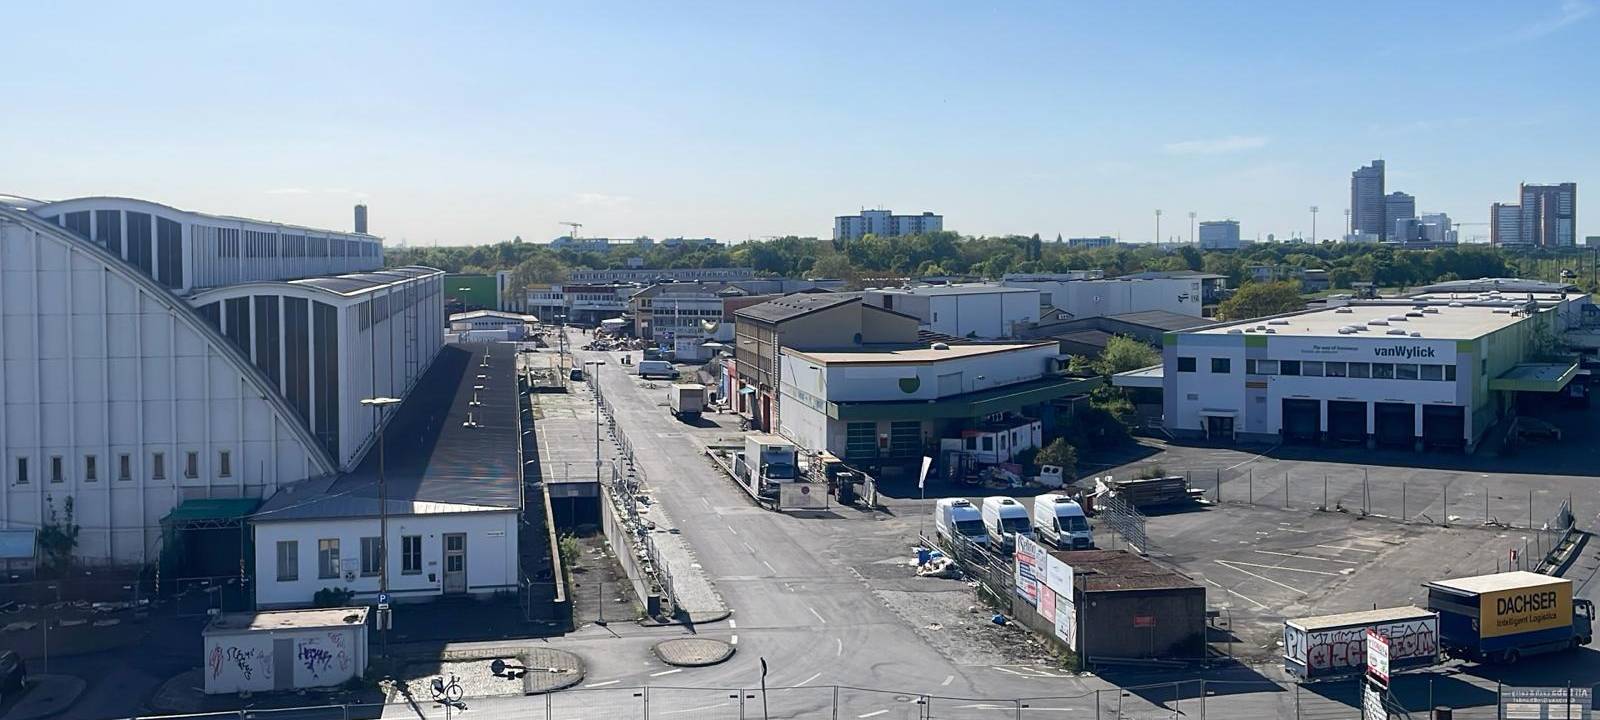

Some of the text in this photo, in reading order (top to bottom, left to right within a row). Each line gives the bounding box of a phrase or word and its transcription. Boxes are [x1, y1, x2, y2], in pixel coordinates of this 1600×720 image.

[1374, 345, 1435, 359] vanWylick
[379, 594, 386, 602] P
[1497, 591, 1556, 615] DACHSER
